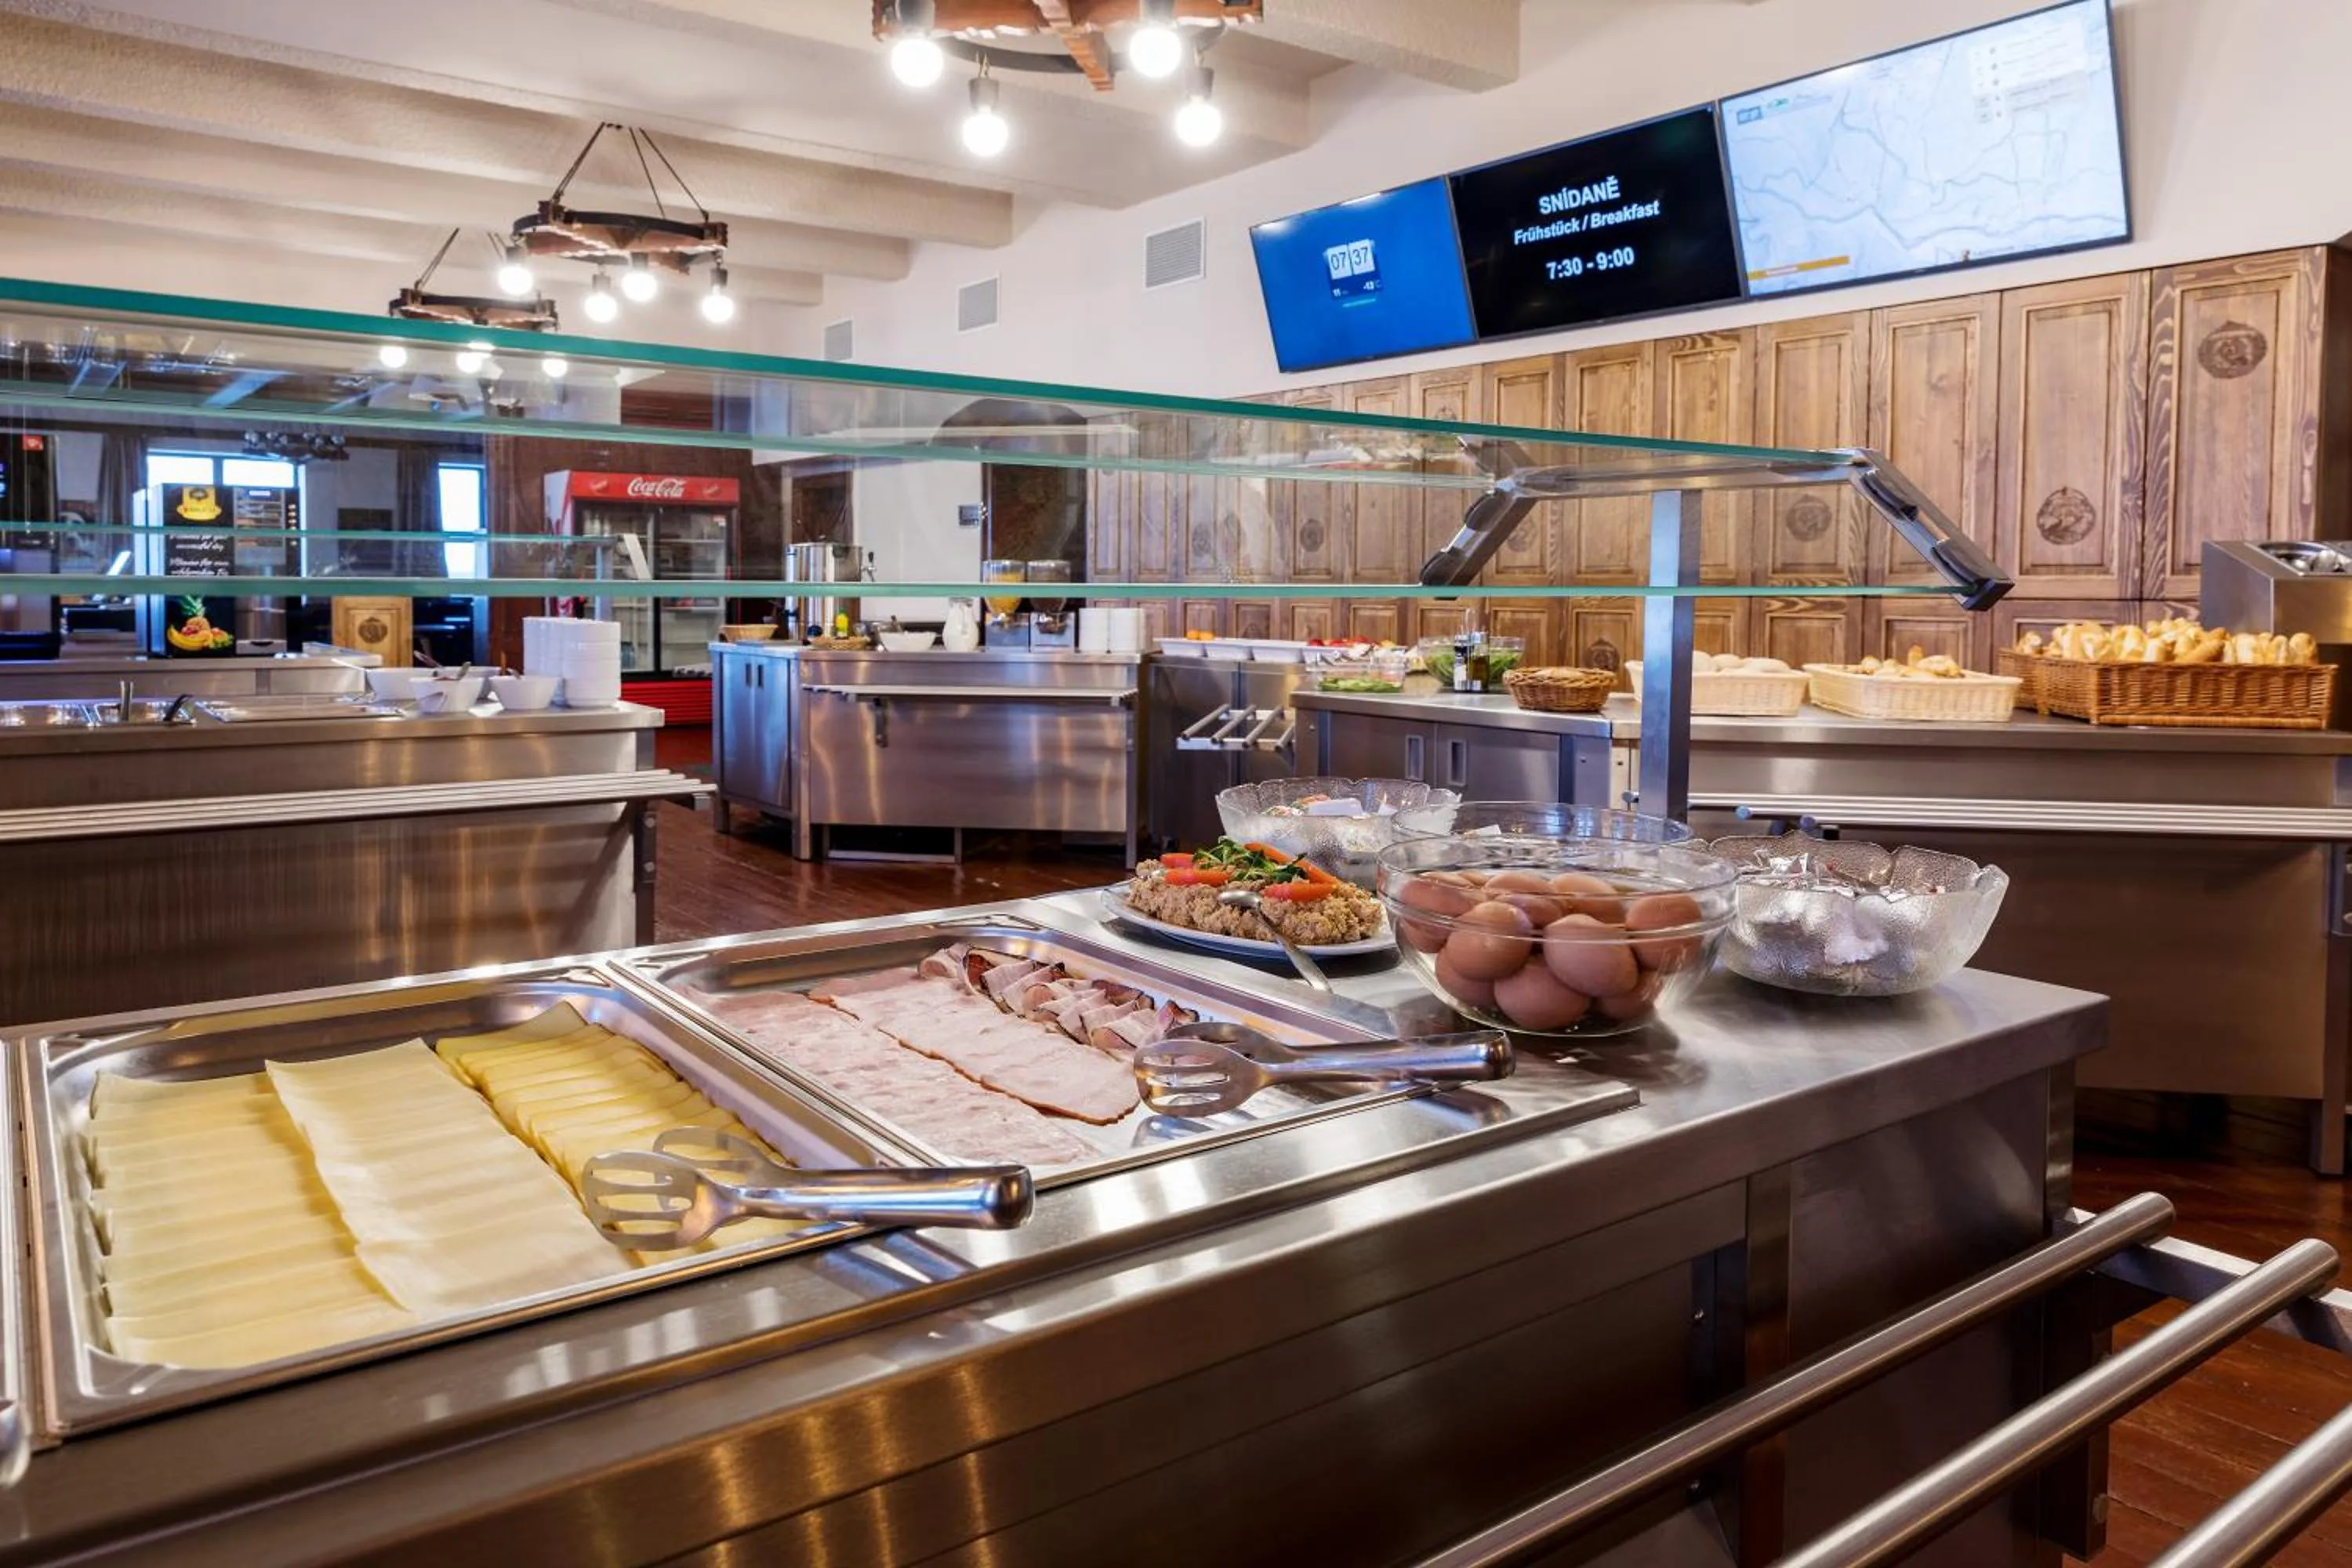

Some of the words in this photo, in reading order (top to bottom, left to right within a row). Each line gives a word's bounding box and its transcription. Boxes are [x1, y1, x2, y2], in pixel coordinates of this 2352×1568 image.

[1539, 175, 1621, 215] SNÍDANĚ
[1514, 217, 1581, 245] Frühstück
[1590, 198, 1661, 229] Breakfast
[1330, 252, 1346, 270] 07
[1352, 245, 1368, 266] 37
[1545, 256, 1583, 279] 7:30
[1595, 246, 1635, 270] 9:00
[626, 476, 688, 498] Coca-Cola
